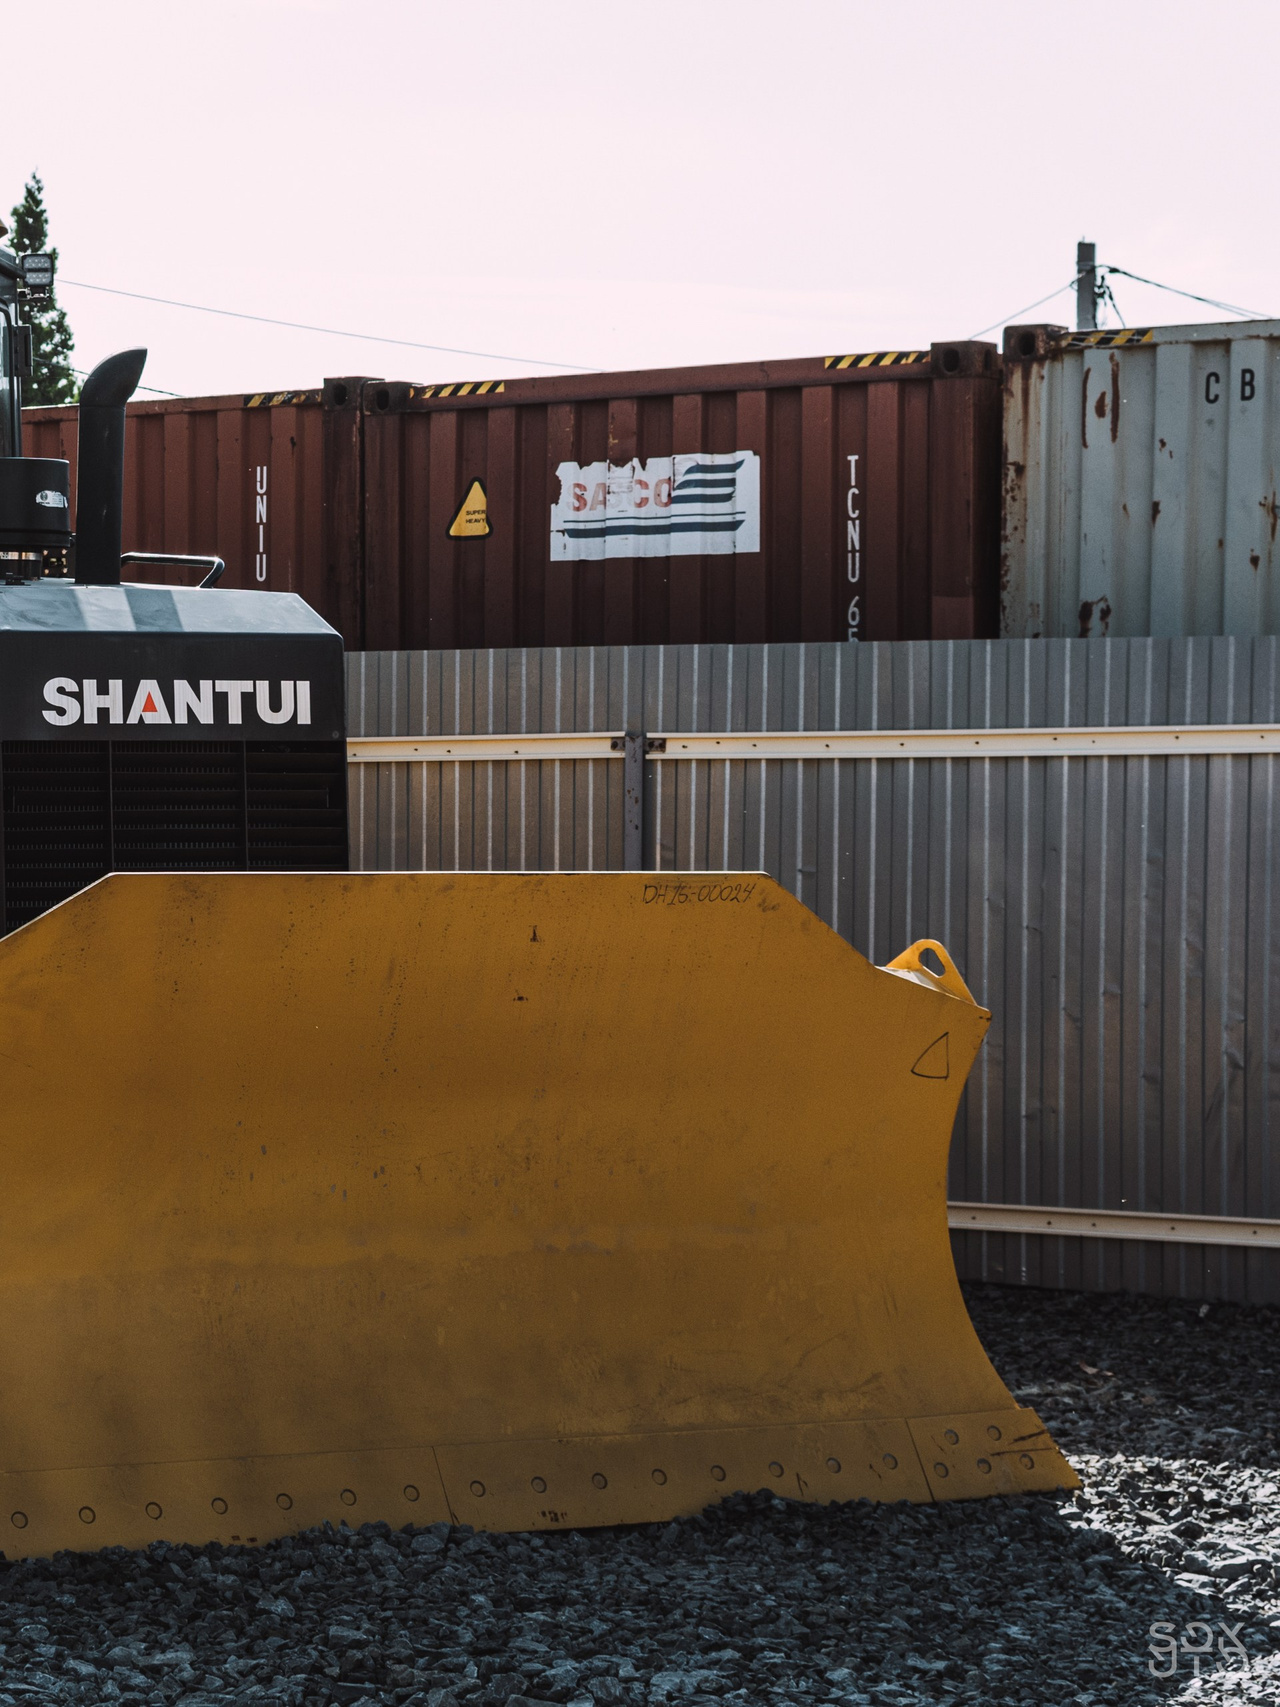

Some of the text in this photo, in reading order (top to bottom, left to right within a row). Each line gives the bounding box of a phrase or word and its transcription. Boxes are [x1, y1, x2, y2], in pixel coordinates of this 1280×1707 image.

[255, 464, 268, 583] UNIU
[567, 477, 672, 513] SACO
[846, 454, 860, 583] TCNU
[41, 675, 312, 726] SHANTUI
